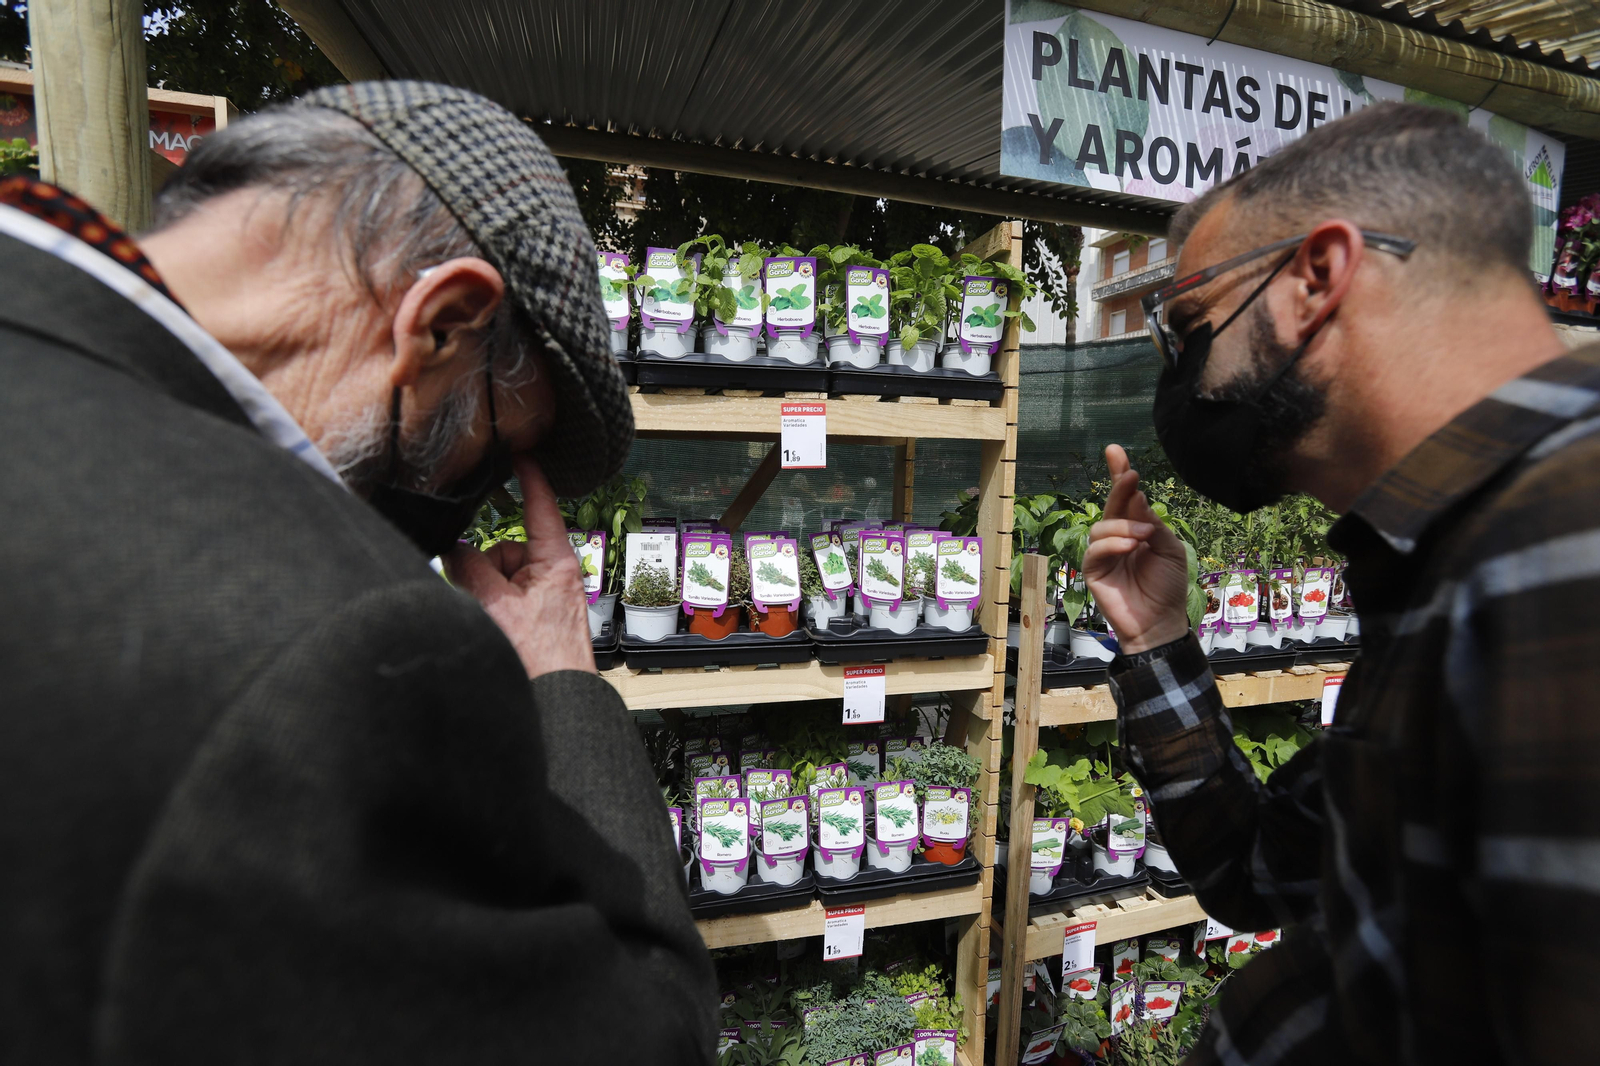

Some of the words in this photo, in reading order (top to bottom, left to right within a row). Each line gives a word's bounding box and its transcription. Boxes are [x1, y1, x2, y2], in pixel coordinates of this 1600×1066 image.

[1031, 31, 1261, 123] PLANTAS
[1274, 83, 1329, 132] DE
[1028, 113, 1064, 166] Y
[1075, 123, 1270, 190] AROMÁ
[1525, 150, 1542, 180] LEROY
[1541, 144, 1557, 189] MERLIN
[650, 252, 674, 262] Family
[650, 259, 676, 268] Garden
[768, 262, 790, 271] Family
[769, 267, 793, 276] Garden
[849, 271, 869, 280] Family
[849, 277, 873, 285] Garden
[967, 280, 988, 290] Family
[967, 286, 990, 295] Garden
[653, 308, 682, 317] Hierbabuena
[783, 449, 790, 462] 1
[813, 536, 826, 545] Family
[909, 534, 928, 542] Family
[687, 543, 706, 551] Family
[815, 540, 831, 549] Garden
[865, 539, 882, 547] Family
[939, 541, 958, 549] Family
[688, 548, 709, 556] Garden
[752, 544, 772, 552] Family
[845, 708, 851, 719] 1
[748, 773, 768, 781] Family
[877, 786, 895, 796] Family
[821, 792, 840, 801] Family
[703, 802, 725, 811] Family
[821, 798, 843, 806] Garden
[763, 802, 784, 812] Family
[764, 807, 789, 816] Garden
[704, 808, 728, 816] Garden
[1066, 926, 1080, 935] SUPER
[1079, 923, 1096, 931] PRECIO
[1207, 926, 1214, 936] 2
[826, 945, 832, 956] 1
[1064, 960, 1071, 972] 2
[917, 1031, 933, 1039] 100%
